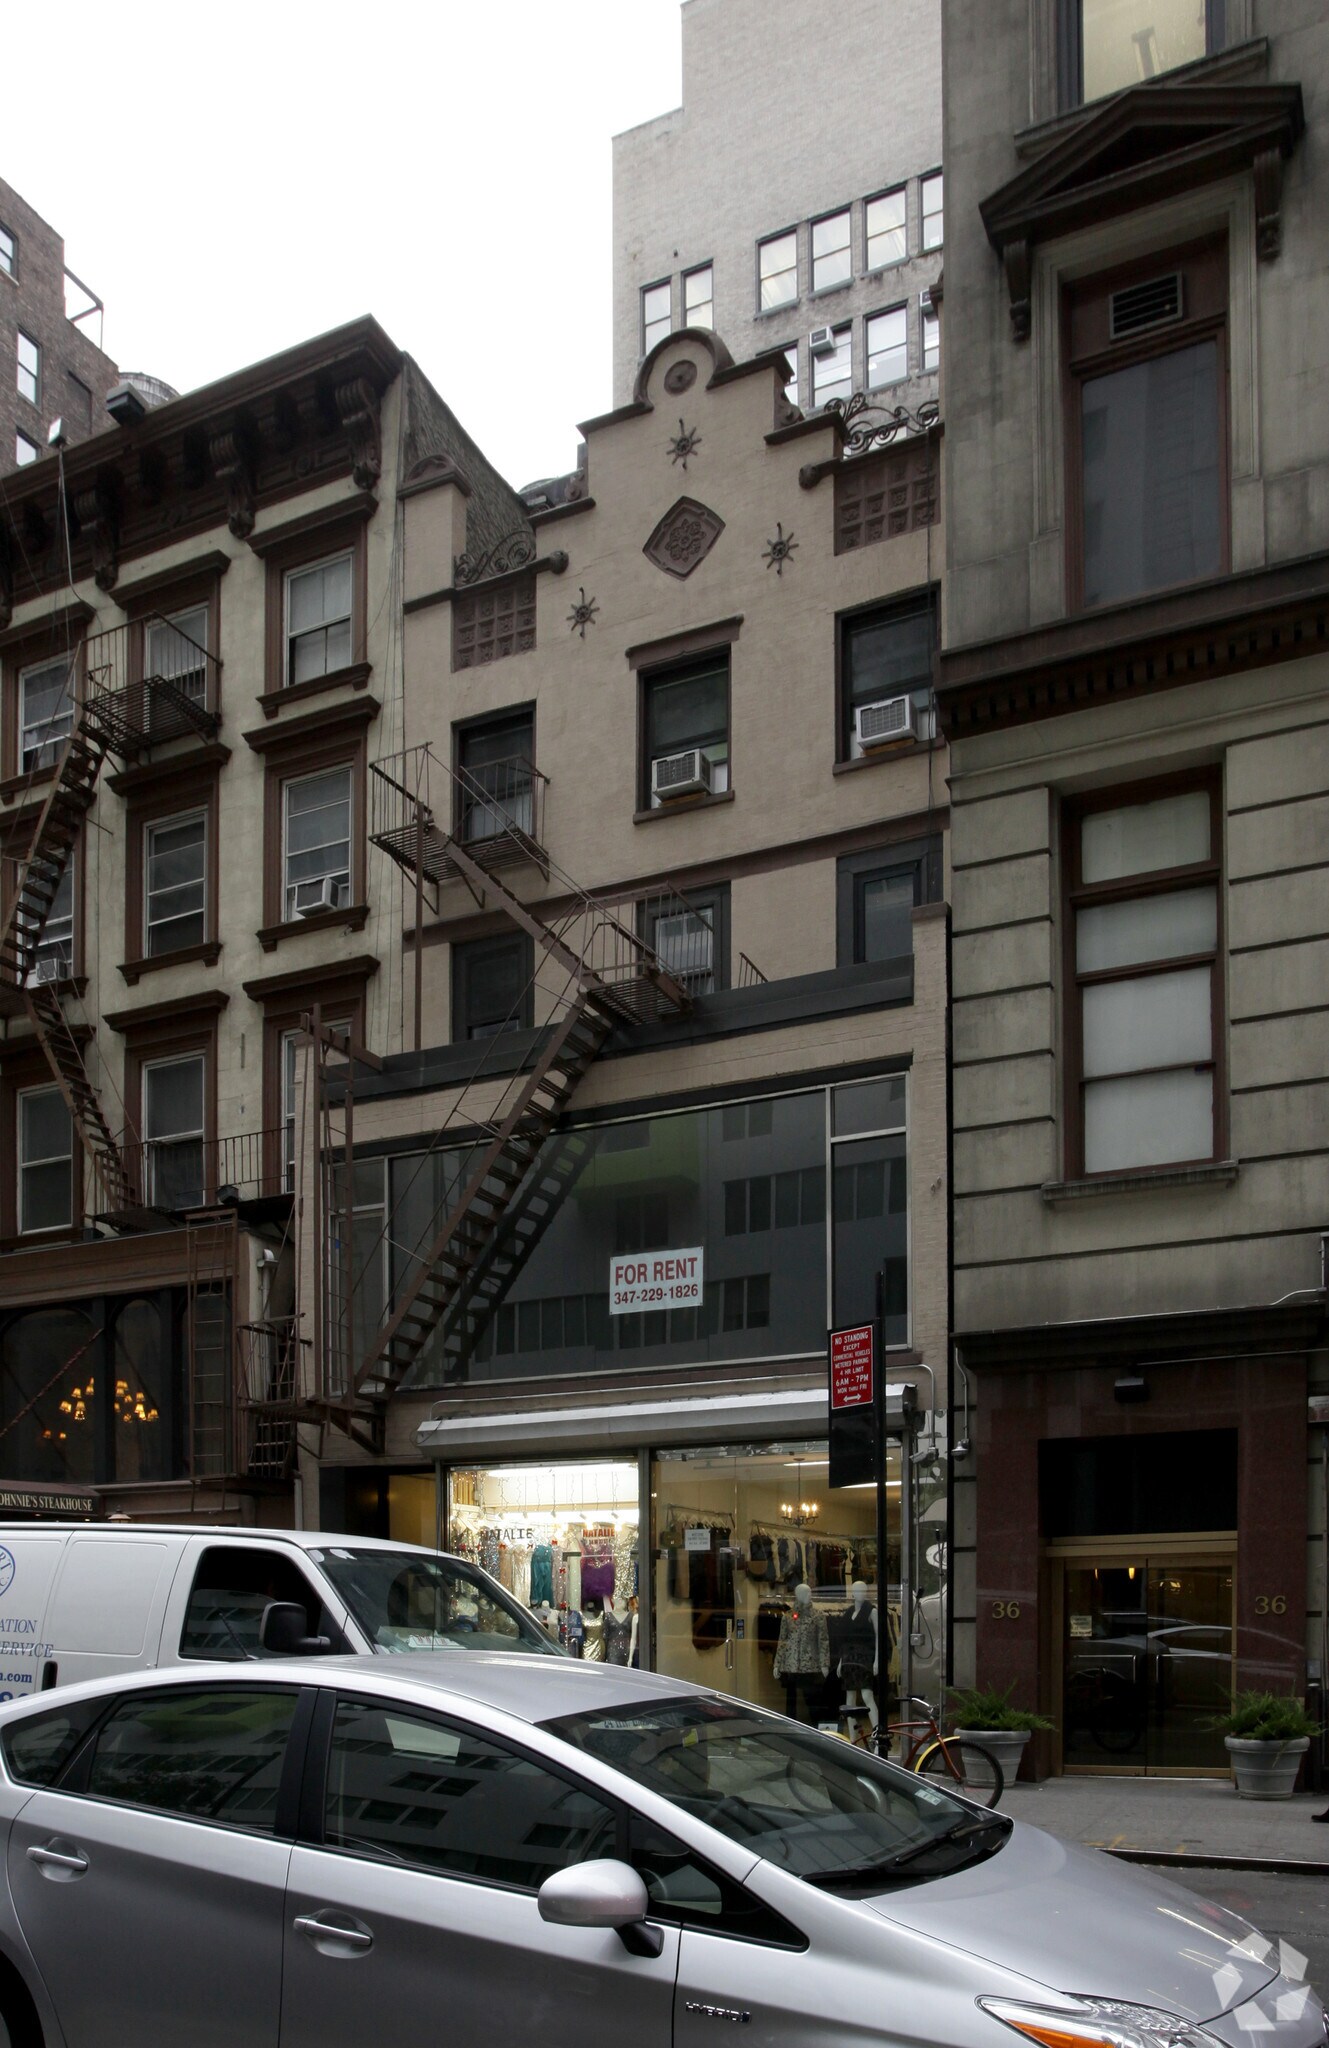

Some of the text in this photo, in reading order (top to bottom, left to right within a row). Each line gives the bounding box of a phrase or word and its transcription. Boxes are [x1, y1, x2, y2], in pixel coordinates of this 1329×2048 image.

[615, 1257, 698, 1286] FOR RENT
[614, 1284, 698, 1305] 347-229-1826
[835, 1331, 868, 1345] NO STANDING
[833, 1349, 870, 1361] COMMERCIAL VEHICLES
[843, 1343, 860, 1351] EXCEPT
[852, 1366, 864, 1374] LIMIT
[837, 1386, 847, 1394] MON
[39, 1496, 93, 1511] STEAKHOUSE
[992, 1601, 1020, 1619] 36
[1255, 1595, 1286, 1615] 36
[0, 1641, 54, 1658] ERVICE
[686, 2002, 739, 2021] HYBRID
